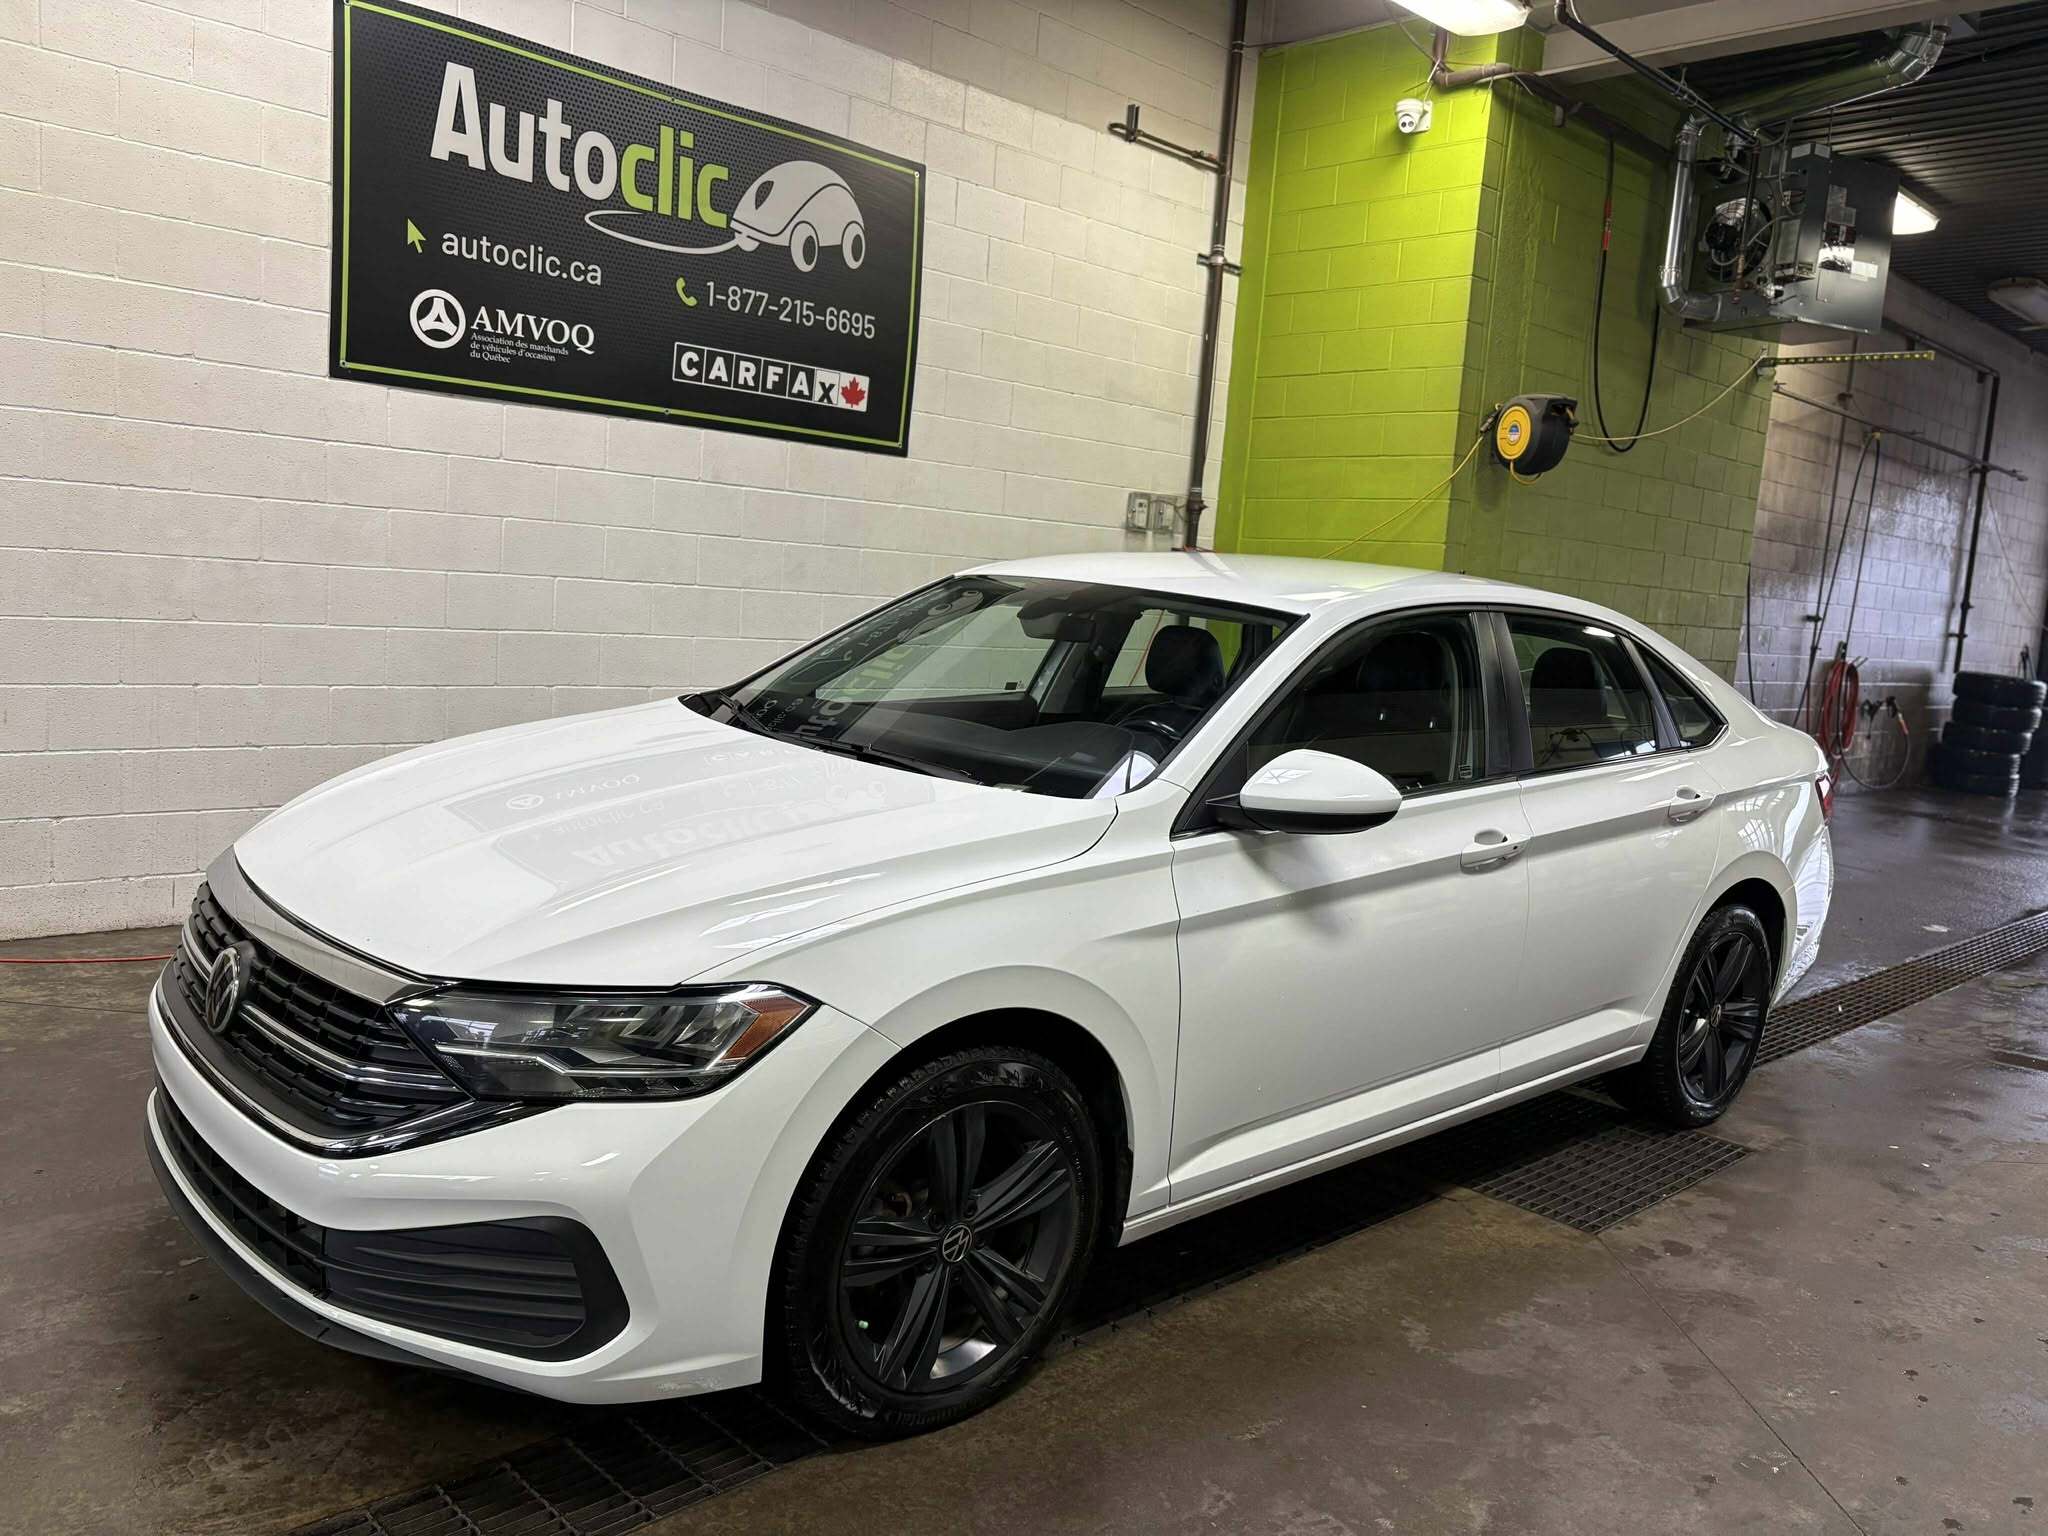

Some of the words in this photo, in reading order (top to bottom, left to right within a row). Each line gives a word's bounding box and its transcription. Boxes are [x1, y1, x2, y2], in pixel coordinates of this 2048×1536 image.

[430, 61, 729, 229] Autoclic
[441, 232, 602, 286] autoclic.ca
[471, 306, 595, 355] AMVOQ
[706, 281, 876, 339] 1-877-215-6695
[470, 332, 514, 347] Association
[515, 340, 528, 349] des
[529, 343, 569, 356] marchands
[470, 341, 481, 350] de
[482, 343, 517, 356] véhicules
[470, 350, 481, 359] du
[482, 351, 511, 364] Québec
[680, 351, 837, 404] CARFAX
